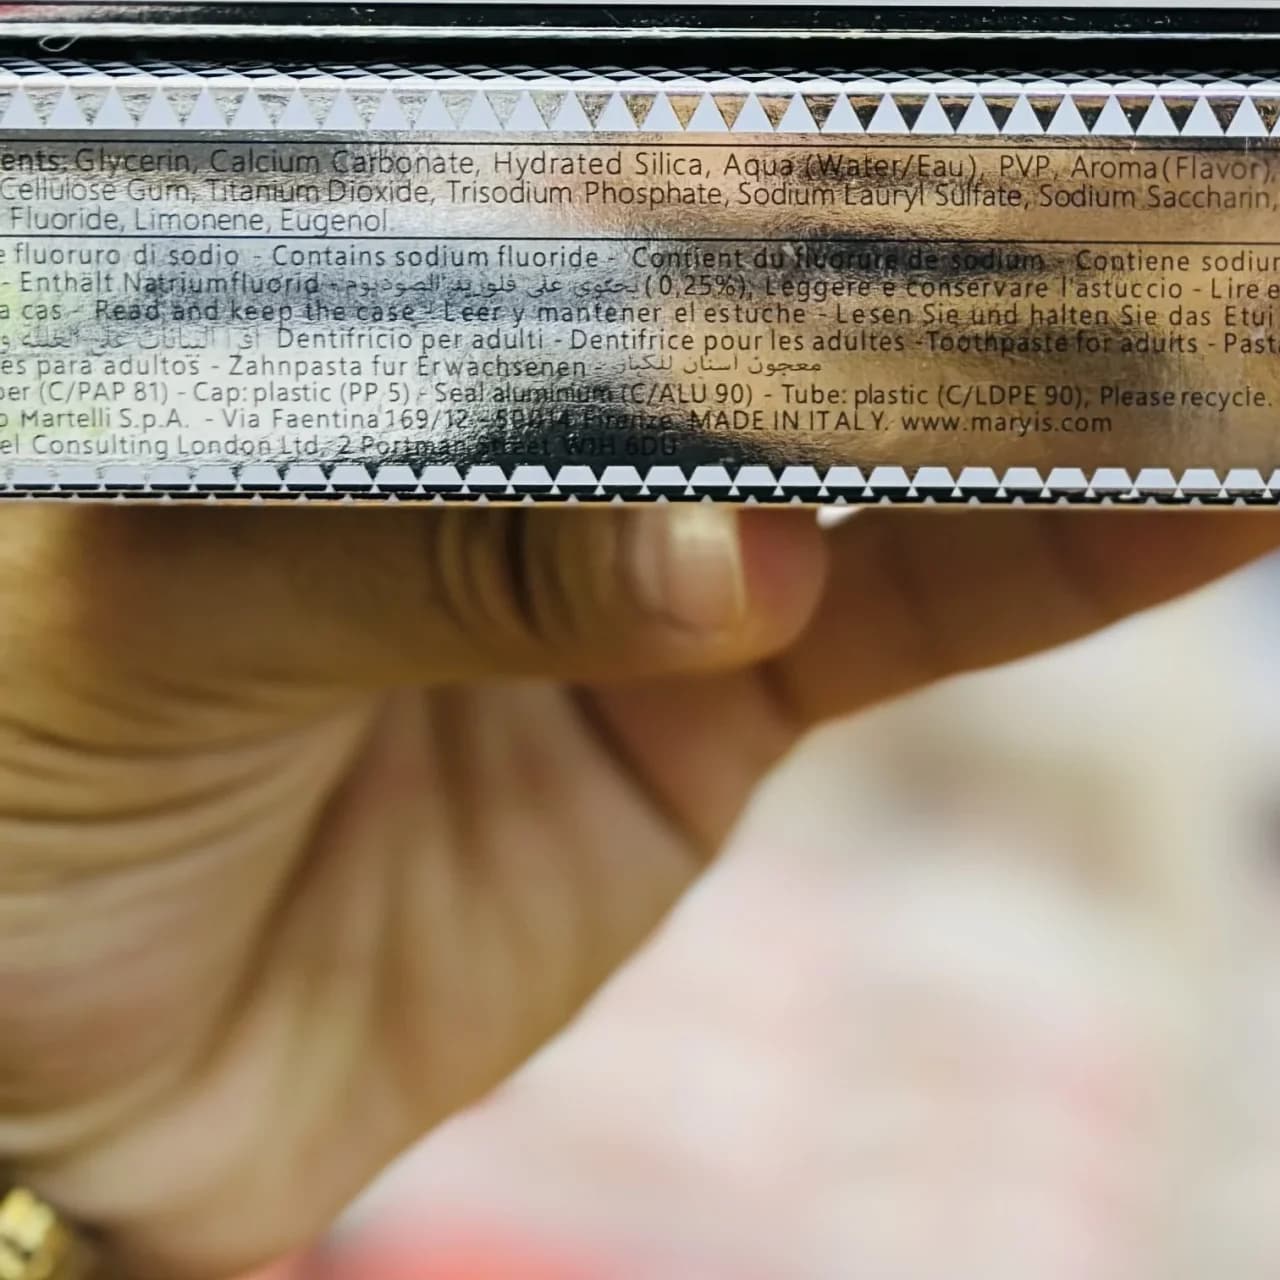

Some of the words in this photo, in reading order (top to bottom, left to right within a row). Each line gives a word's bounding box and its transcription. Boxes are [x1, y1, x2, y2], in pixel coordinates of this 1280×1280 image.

[75, 147, 198, 177] Glycerin,
[211, 148, 320, 173] Calcium
[332, 149, 481, 177] Carbonate,
[494, 150, 621, 180] Hydrated
[636, 151, 711, 179] Silica,
[724, 153, 794, 182] Aqua
[1000, 154, 1059, 181] PVP,
[0, 176, 116, 202] Cellulose
[127, 177, 197, 204] Gum,
[205, 178, 319, 203] Titanium
[328, 179, 436, 206] Dioxide,
[446, 180, 573, 204] Trisodium
[585, 180, 729, 210] Phosphate,
[738, 181, 835, 206] Sodium
[844, 182, 924, 212] Lauryl
[935, 183, 1030, 210] Sulfate,
[1039, 184, 1136, 208] Sodium
[1147, 185, 1278, 212] Saccharin,
[10, 206, 126, 233] Fluoride,
[135, 208, 273, 234] Limonene,
[16, 242, 121, 266] fluoruro
[134, 243, 156, 266] di
[168, 245, 240, 267] sodio
[272, 244, 386, 268] Contains
[395, 245, 489, 268] sodium
[498, 245, 599, 268] fluoride
[632, 246, 745, 270] Contient
[753, 247, 784, 270] du
[951, 250, 1046, 272] sodium
[1076, 249, 1190, 273] Contiene
[124, 270, 319, 295] Natriumfluorid
[766, 277, 870, 303] Leggere
[882, 282, 895, 298] e
[906, 281, 1049, 299] conservare
[1061, 277, 1183, 300] l'astuccio
[1211, 278, 1260, 301] Lire
[22, 305, 62, 321] cas
[95, 299, 159, 322] Read
[172, 299, 218, 322] and
[231, 299, 293, 330] keep
[306, 299, 346, 322] the
[356, 305, 415, 322] case
[537, 302, 662, 324] mantener
[675, 300, 695, 324] el
[704, 301, 806, 325] estuche
[837, 301, 912, 325] Lesen
[922, 301, 960, 326] Sie
[971, 302, 1018, 326] und
[1030, 302, 1111, 326] halten
[1121, 303, 1157, 327] Sie
[1169, 303, 1211, 327] das
[1225, 304, 1274, 327] Etui
[278, 326, 412, 350] Dentifricio
[422, 329, 462, 355] per
[473, 326, 544, 350] adulti
[572, 327, 695, 352] Dentifrice
[704, 333, 764, 358] pour
[771, 329, 805, 352] les
[813, 328, 906, 353] adultes
[927, 329, 1069, 358] Toothpaste
[1077, 330, 1111, 354] for
[37, 360, 93, 381] para
[103, 354, 200, 377] adultos
[229, 354, 362, 381] Zahnpasta
[417, 354, 586, 378] Erwachsenen
[39, 381, 126, 405] (C/PAP
[135, 381, 168, 405] 81)
[194, 381, 248, 407] Cap:
[255, 380, 332, 407] plastic
[340, 381, 379, 406] (PP
[389, 382, 412, 406] 5)
[434, 382, 485, 403] Seal
[716, 383, 753, 408] 90)
[782, 384, 848, 406] Tube:
[855, 384, 928, 410] plastic
[937, 384, 1037, 410] (C/LDPE
[1101, 386, 1176, 408] Please
[1181, 386, 1273, 413] recycle.
[21, 407, 111, 429] Martelli
[120, 407, 190, 433] S.p.A.
[223, 408, 261, 429] Via
[273, 408, 379, 430] Faentina
[690, 410, 765, 431] MADE
[773, 410, 801, 431] IN
[31, 434, 169, 461] Consulting
[178, 434, 273, 456] London
